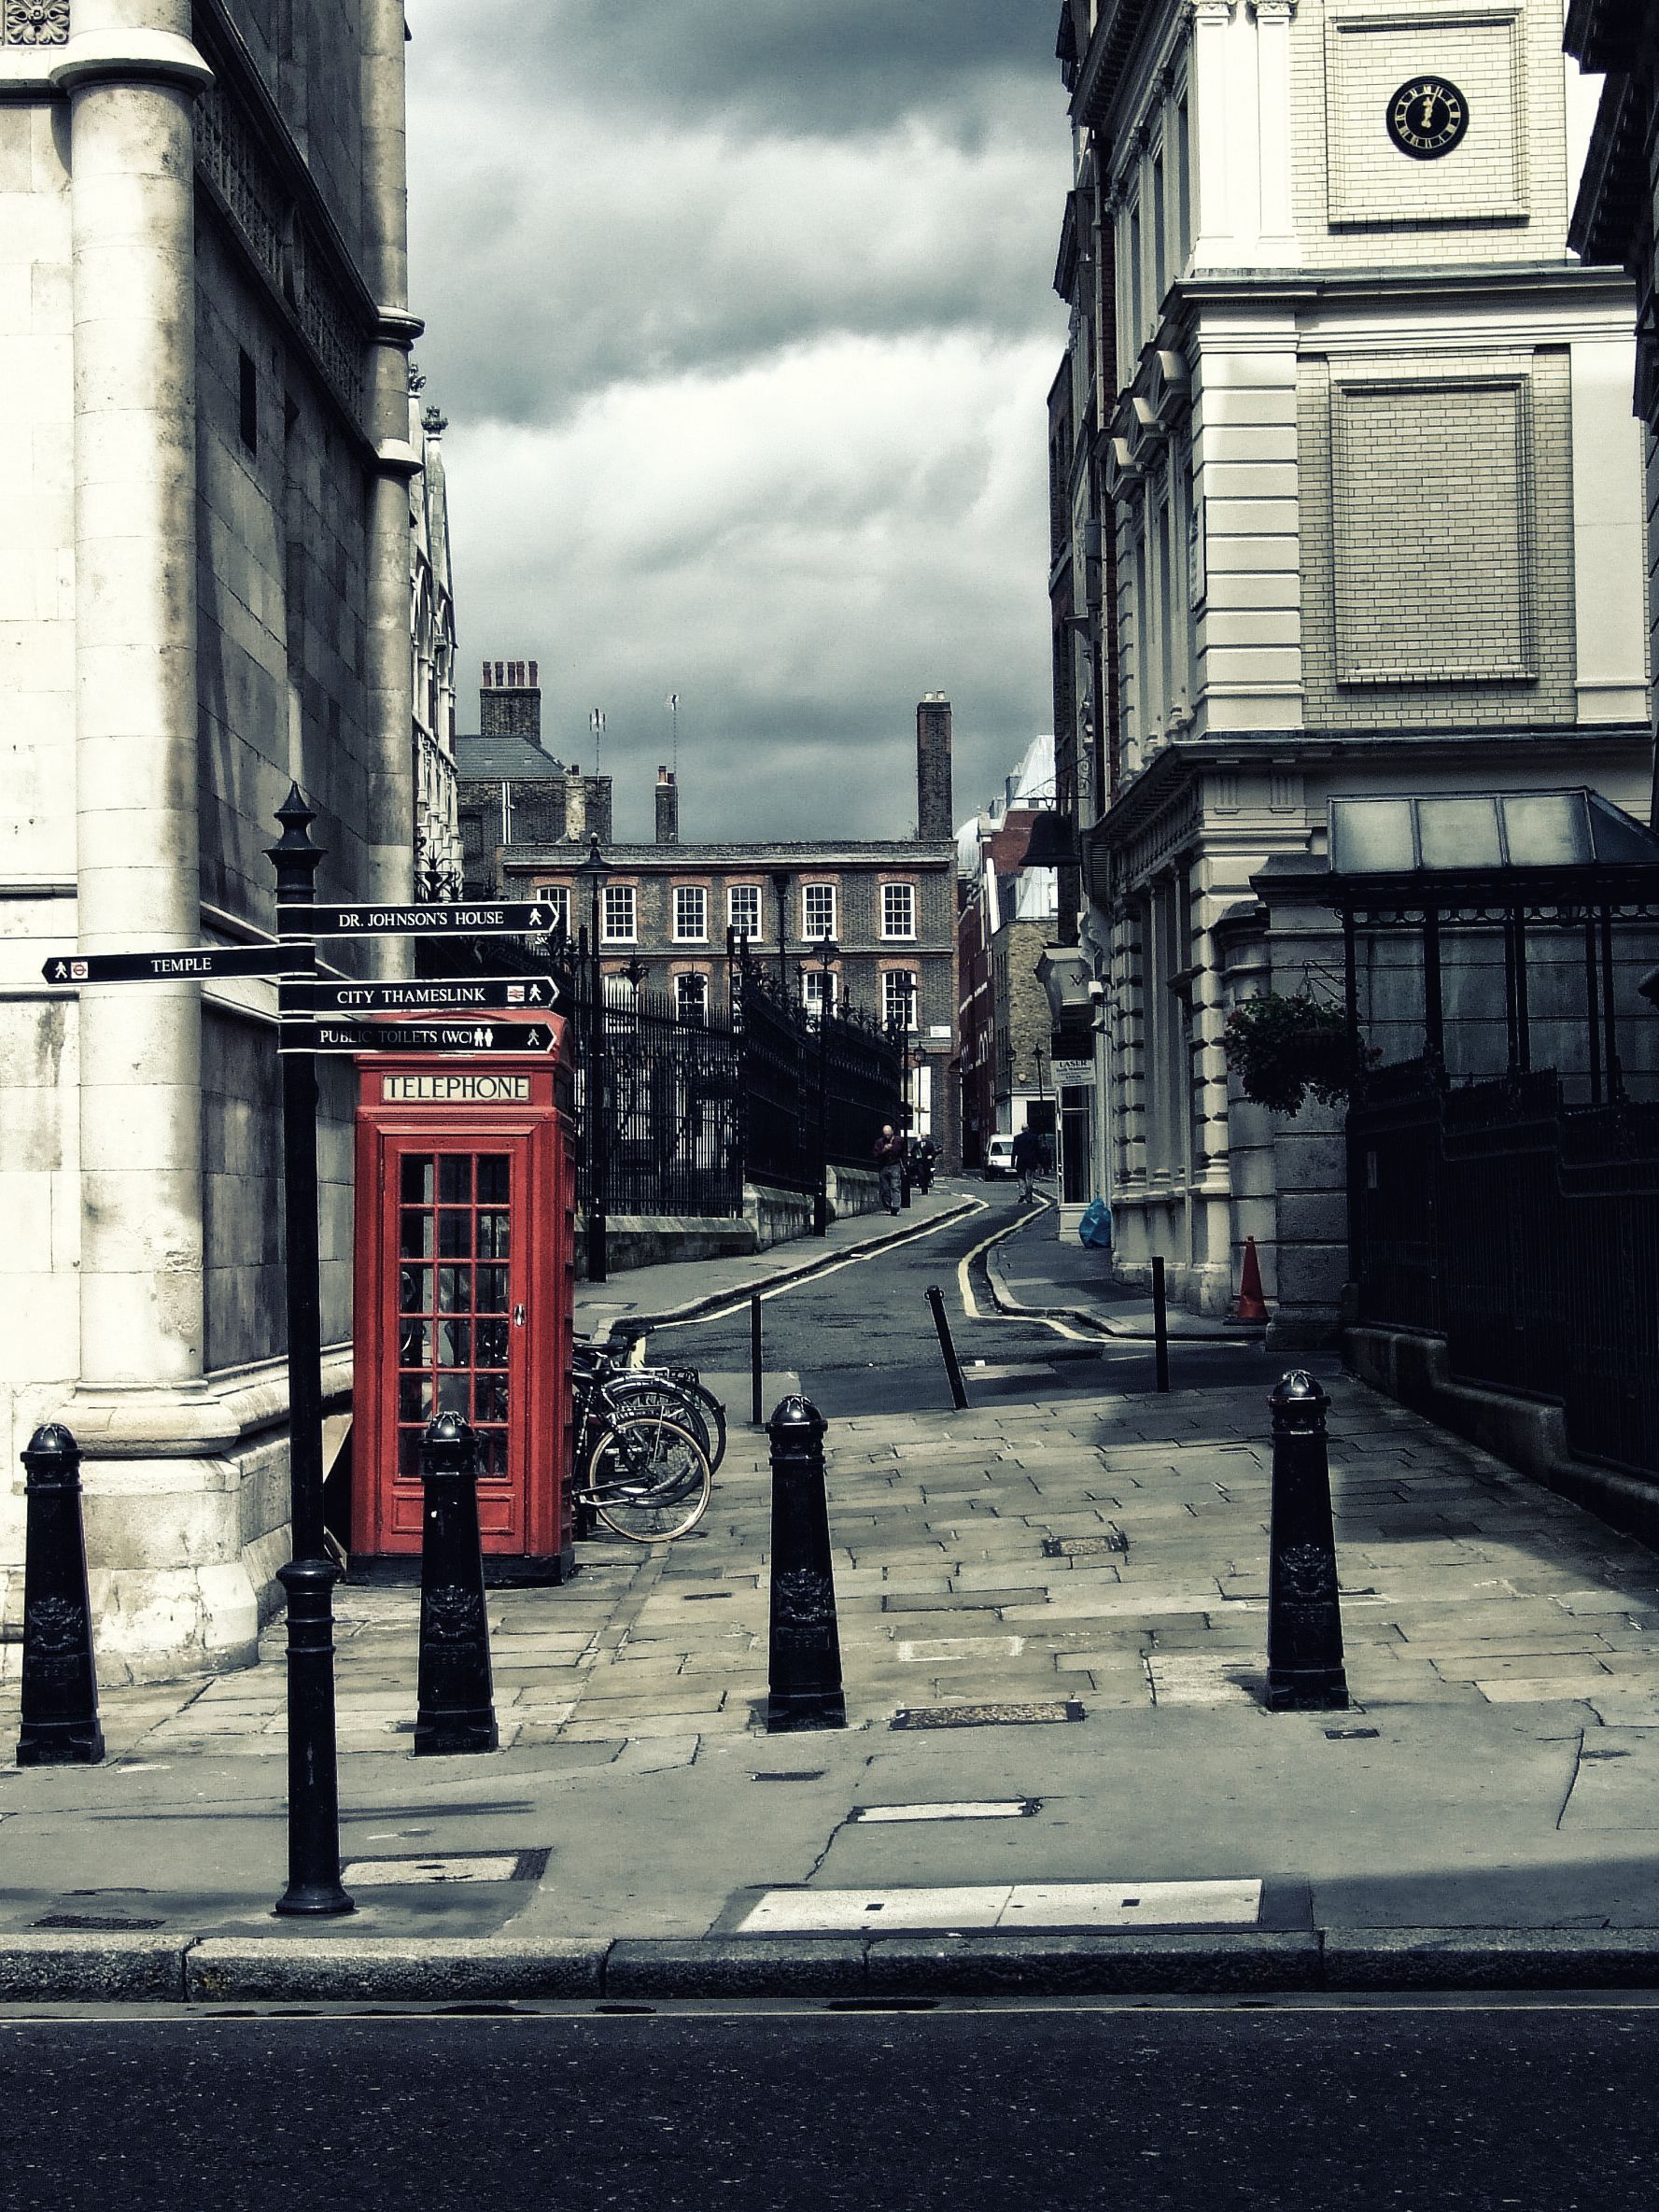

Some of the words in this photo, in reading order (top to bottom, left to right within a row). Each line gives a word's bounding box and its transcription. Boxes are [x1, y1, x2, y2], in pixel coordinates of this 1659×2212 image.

[338, 914, 364, 927] DR.
[368, 912, 448, 926] JOHNSON'S
[455, 911, 504, 924] HOUSE
[150, 957, 212, 972] TEMPLE
[337, 991, 374, 1004] CITY
[382, 988, 486, 1004] THAMESLINK
[319, 1031, 373, 1043] PUBLIC
[378, 1030, 438, 1043] TOILETS
[442, 1030, 472, 1044] (WC)
[387, 1077, 528, 1098] TELEPHONE
